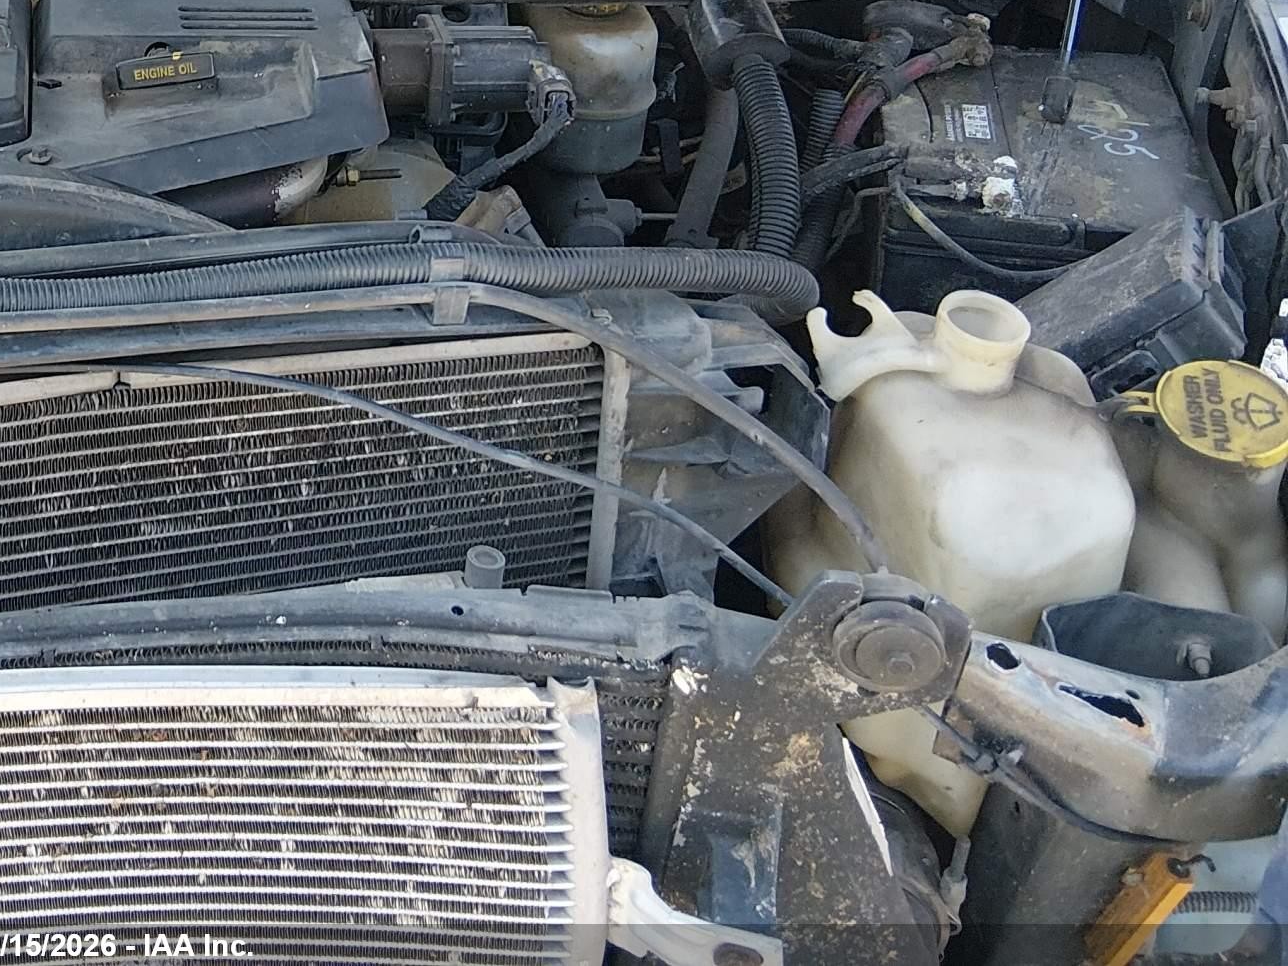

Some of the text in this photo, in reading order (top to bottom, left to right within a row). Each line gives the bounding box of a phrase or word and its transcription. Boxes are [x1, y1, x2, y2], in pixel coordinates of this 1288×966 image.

[134, 62, 197, 80] ENGINE OIL
[1183, 375, 1208, 439] WASHER
[1202, 368, 1231, 452] FLUID ONLY
